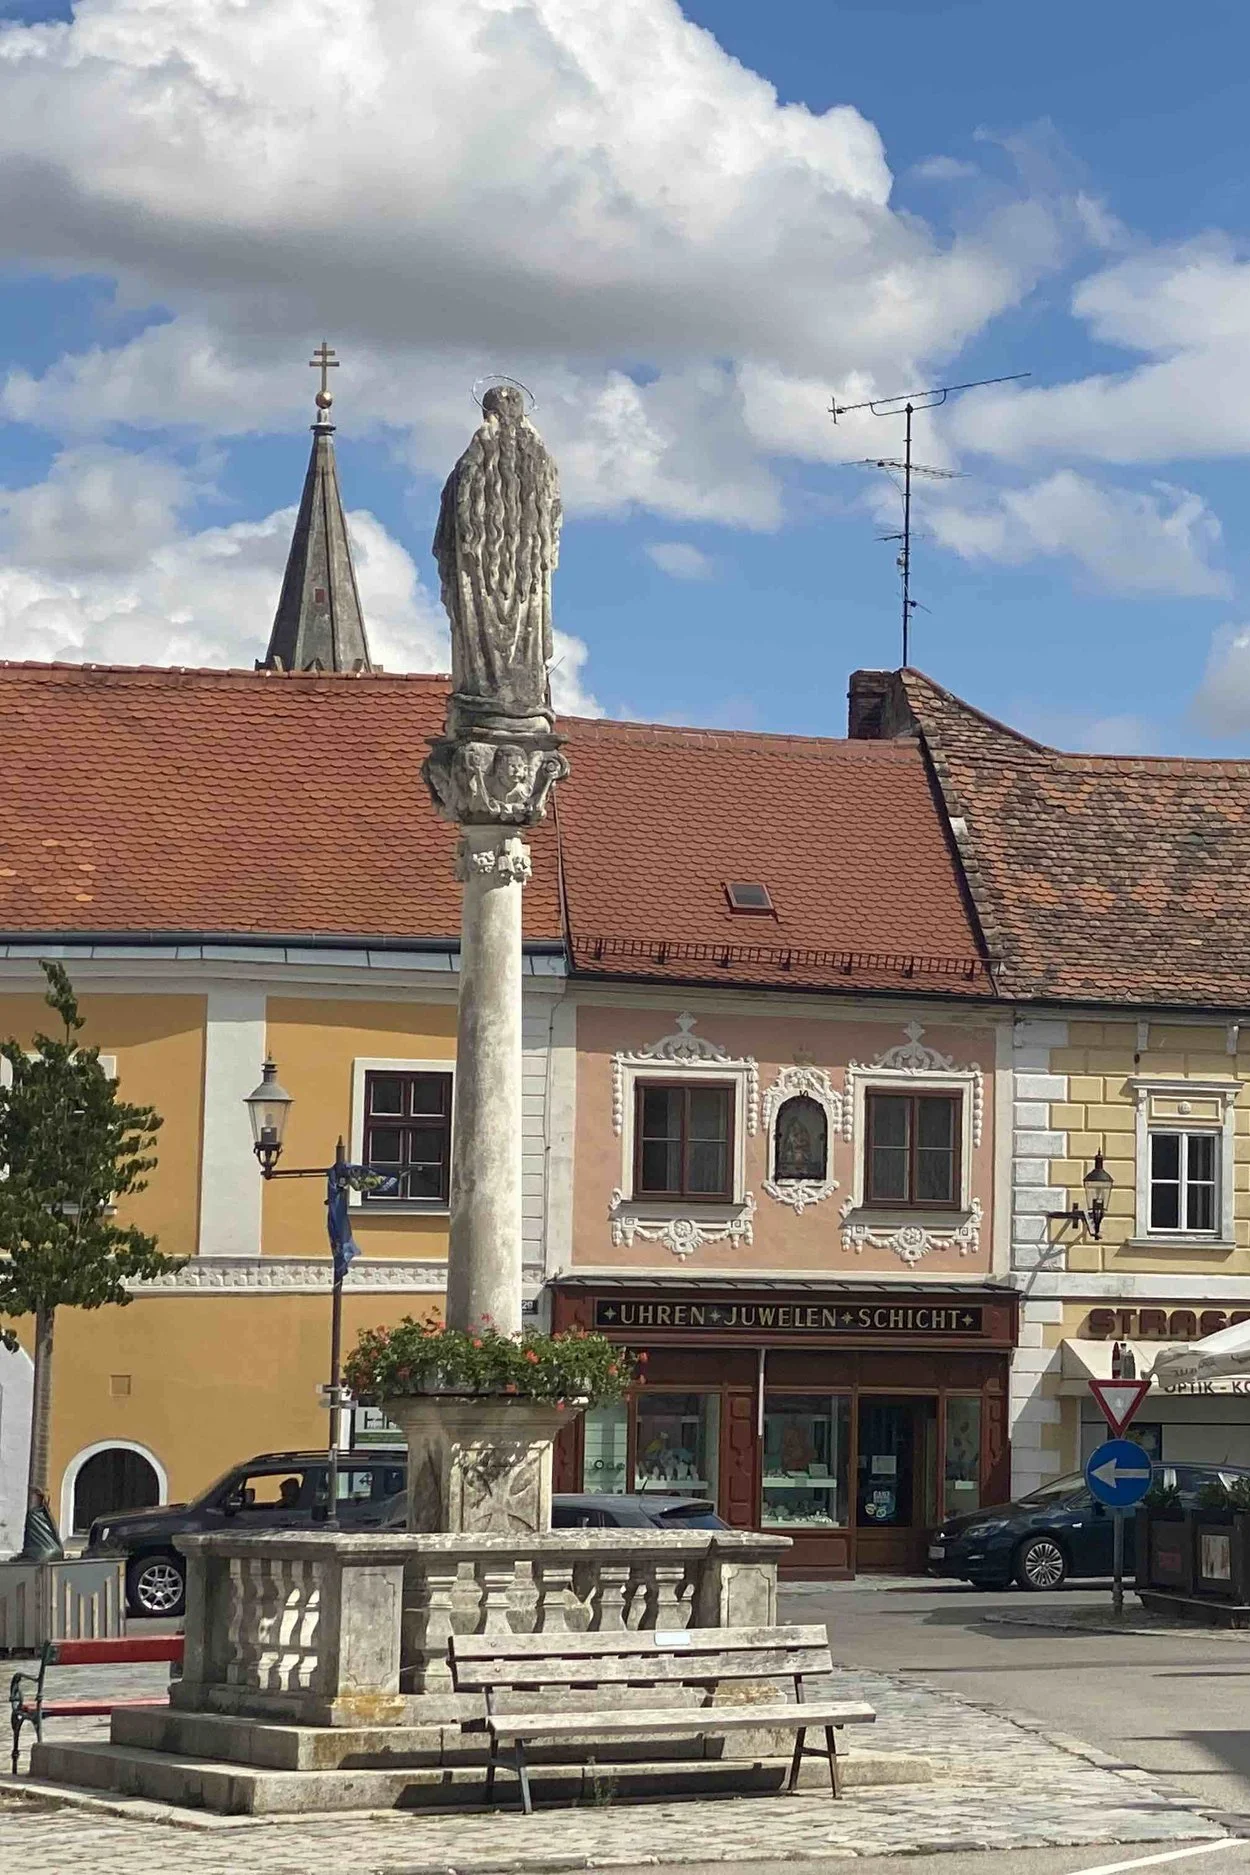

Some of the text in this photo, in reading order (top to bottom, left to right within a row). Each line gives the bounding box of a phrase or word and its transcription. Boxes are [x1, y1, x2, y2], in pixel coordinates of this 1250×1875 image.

[620, 1304, 962, 1330] UHREN JUWELEN SCHICHT
